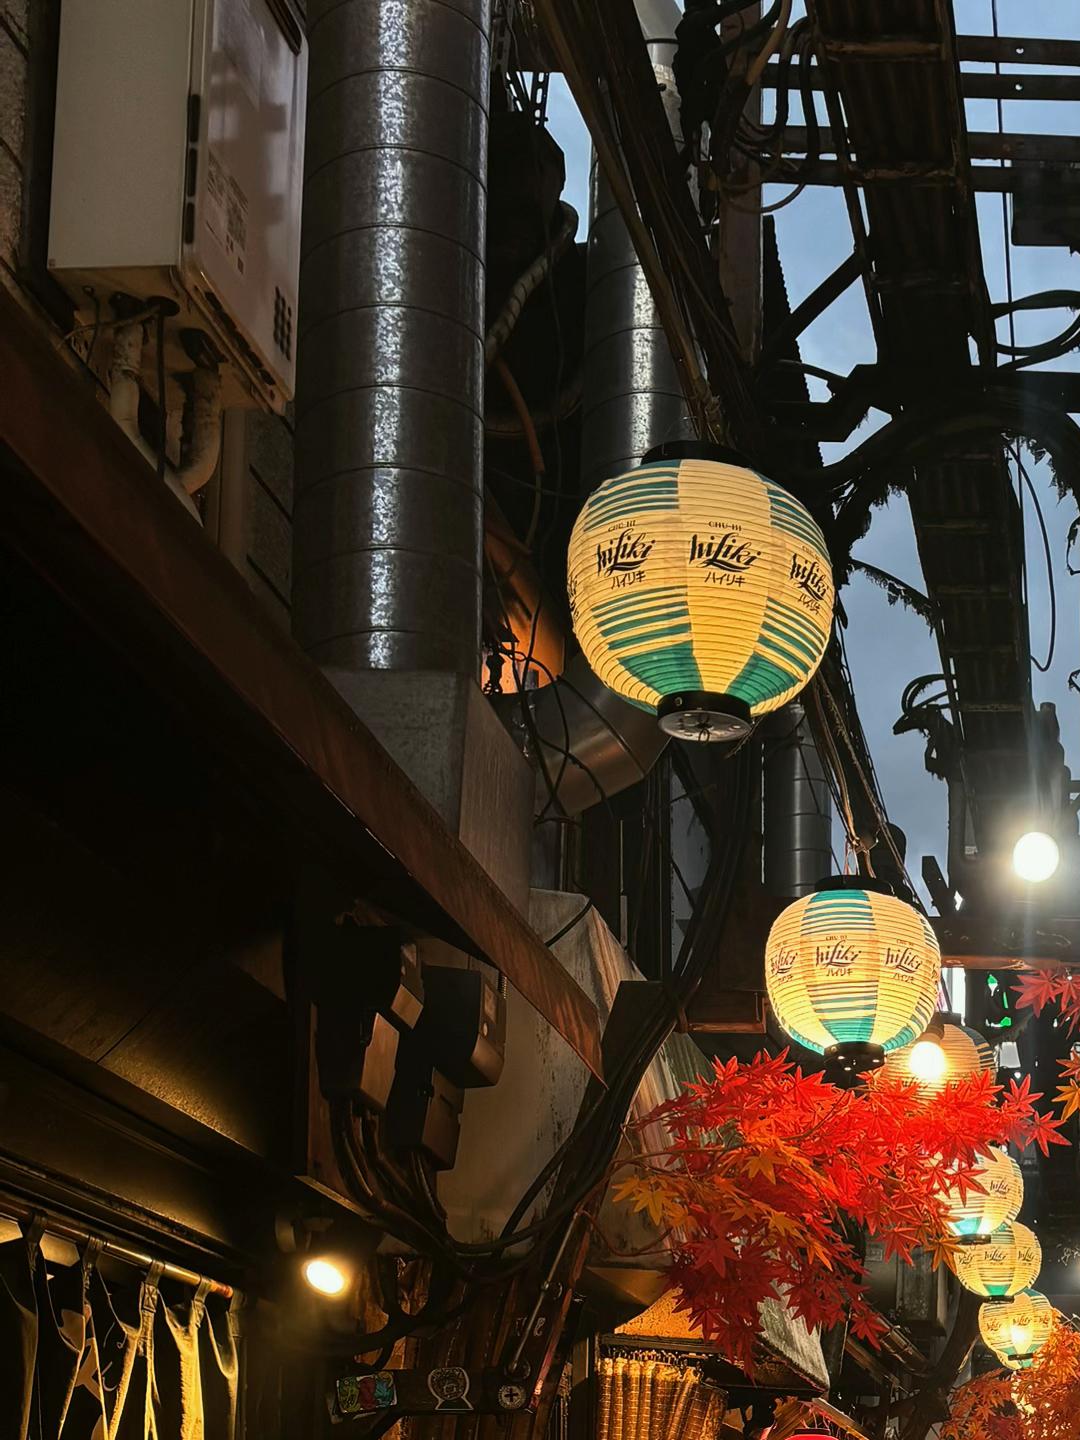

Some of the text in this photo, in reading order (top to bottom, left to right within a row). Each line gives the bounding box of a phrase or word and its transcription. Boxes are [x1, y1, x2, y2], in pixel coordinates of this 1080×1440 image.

[611, 571, 646, 590] ハイリキ
[704, 571, 746, 588] ハイリキ
